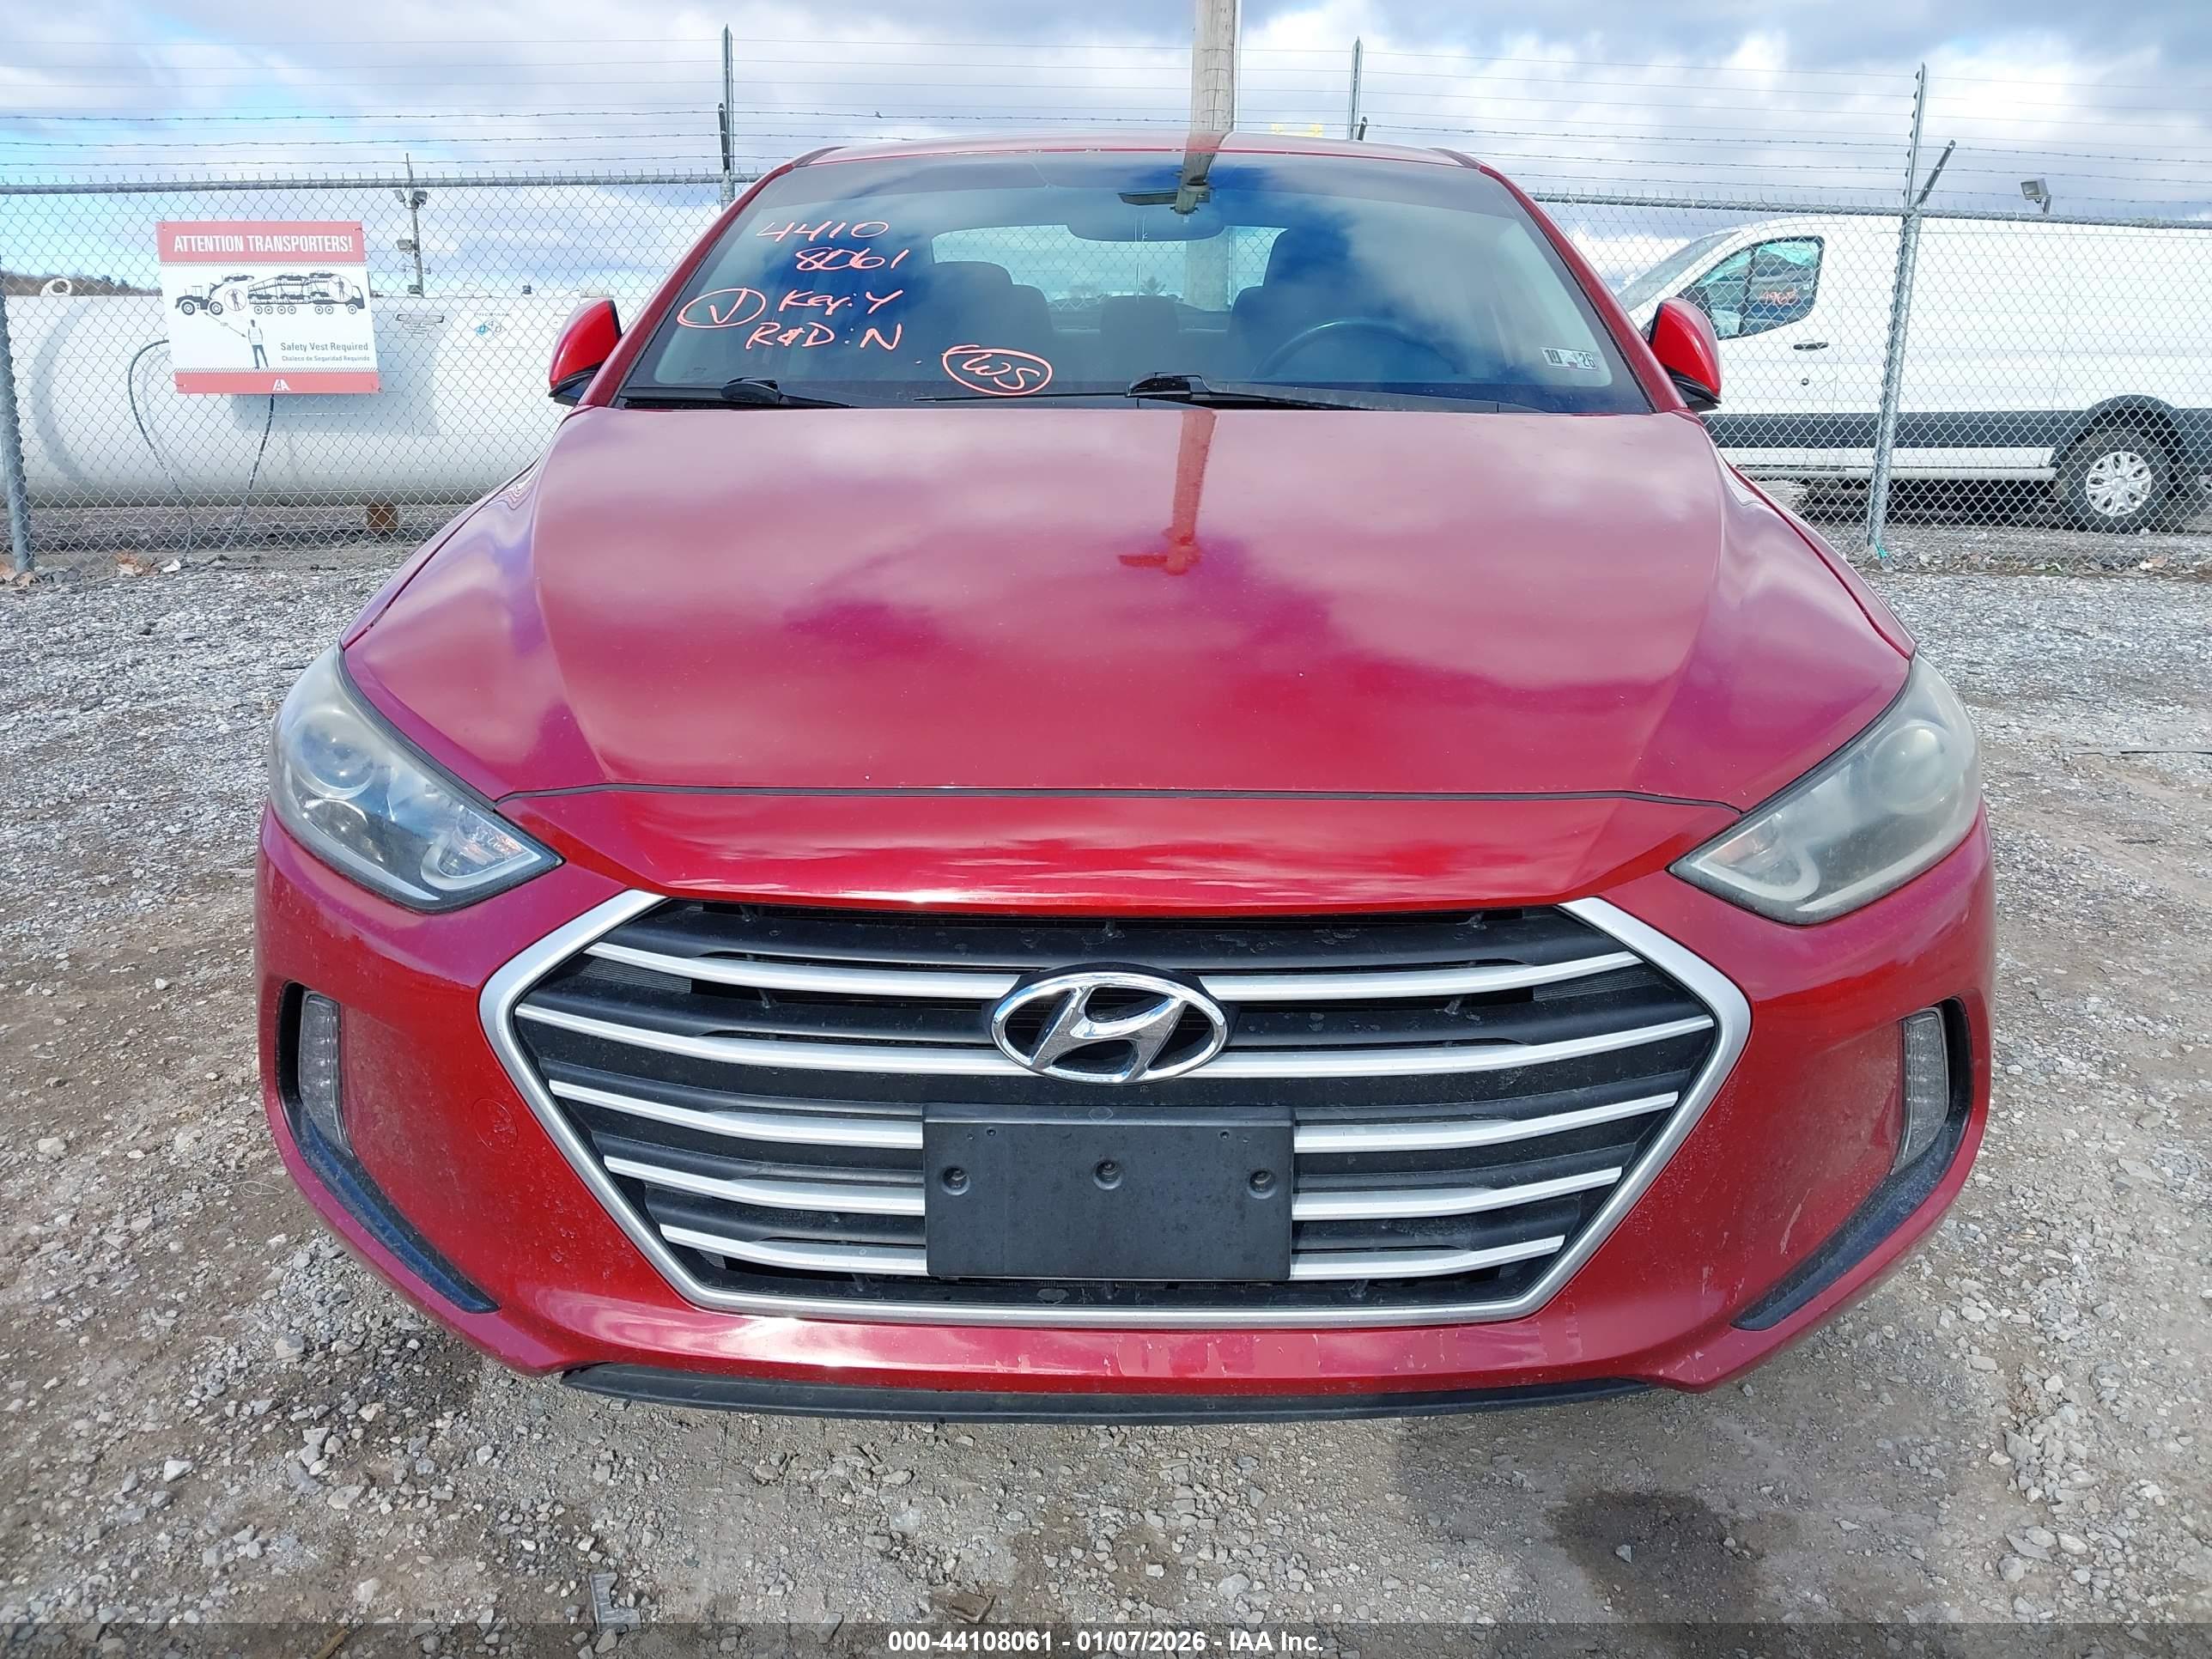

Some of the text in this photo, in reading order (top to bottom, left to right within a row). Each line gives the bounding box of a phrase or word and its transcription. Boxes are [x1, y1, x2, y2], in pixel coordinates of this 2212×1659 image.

[755, 220, 890, 242] 4410
[173, 234, 354, 252] ATTENTION TRANSPORTERS!
[794, 246, 910, 271] 8061
[859, 323, 903, 350] N
[280, 342, 369, 352] Safety Vest Required
[1578, 352, 1596, 368] 26
